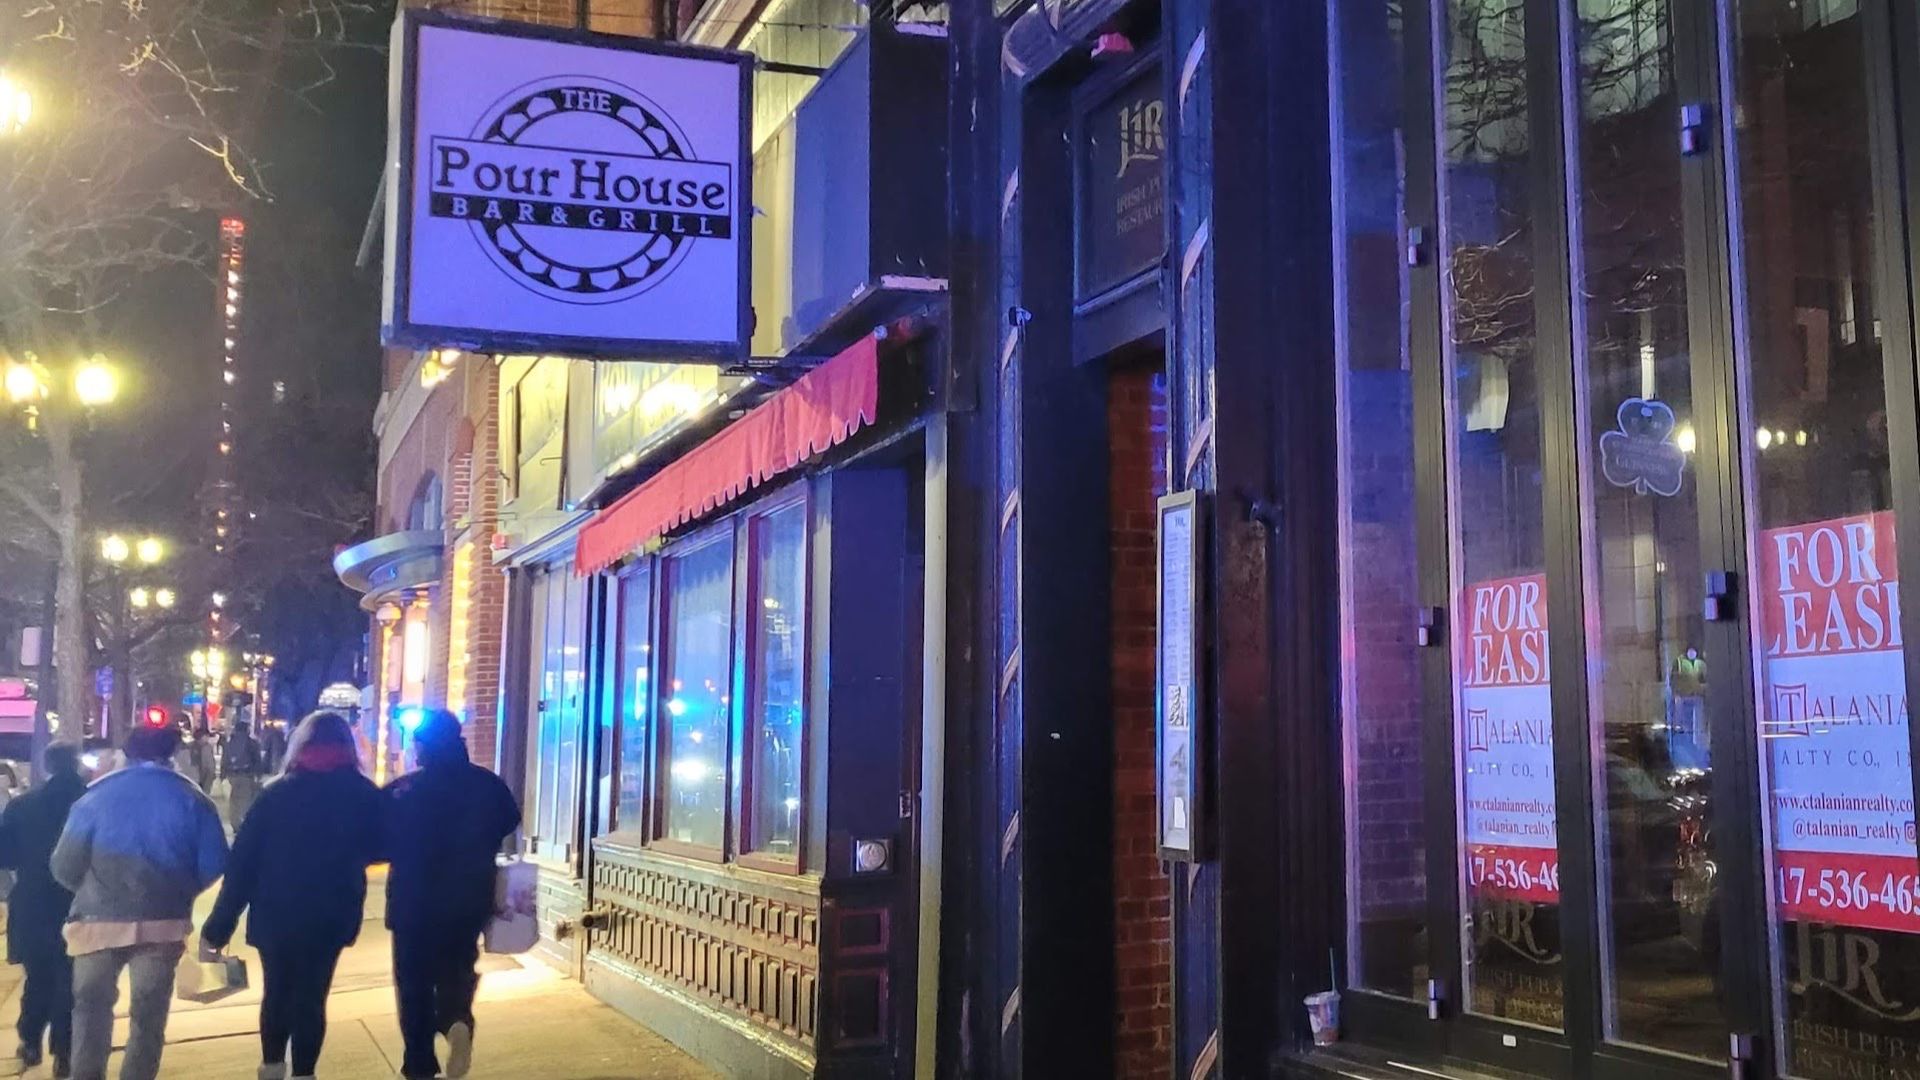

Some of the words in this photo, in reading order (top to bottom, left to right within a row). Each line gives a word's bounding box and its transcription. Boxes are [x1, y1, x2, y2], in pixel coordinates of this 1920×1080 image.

[560, 88, 612, 113] THE
[435, 145, 560, 198] Pour
[570, 158, 726, 210] House
[1773, 522, 1882, 592] FOR
[1472, 581, 1540, 634] FOR
[1470, 713, 1552, 746] TALANI
[1793, 817, 1900, 845] @talanian_realty
